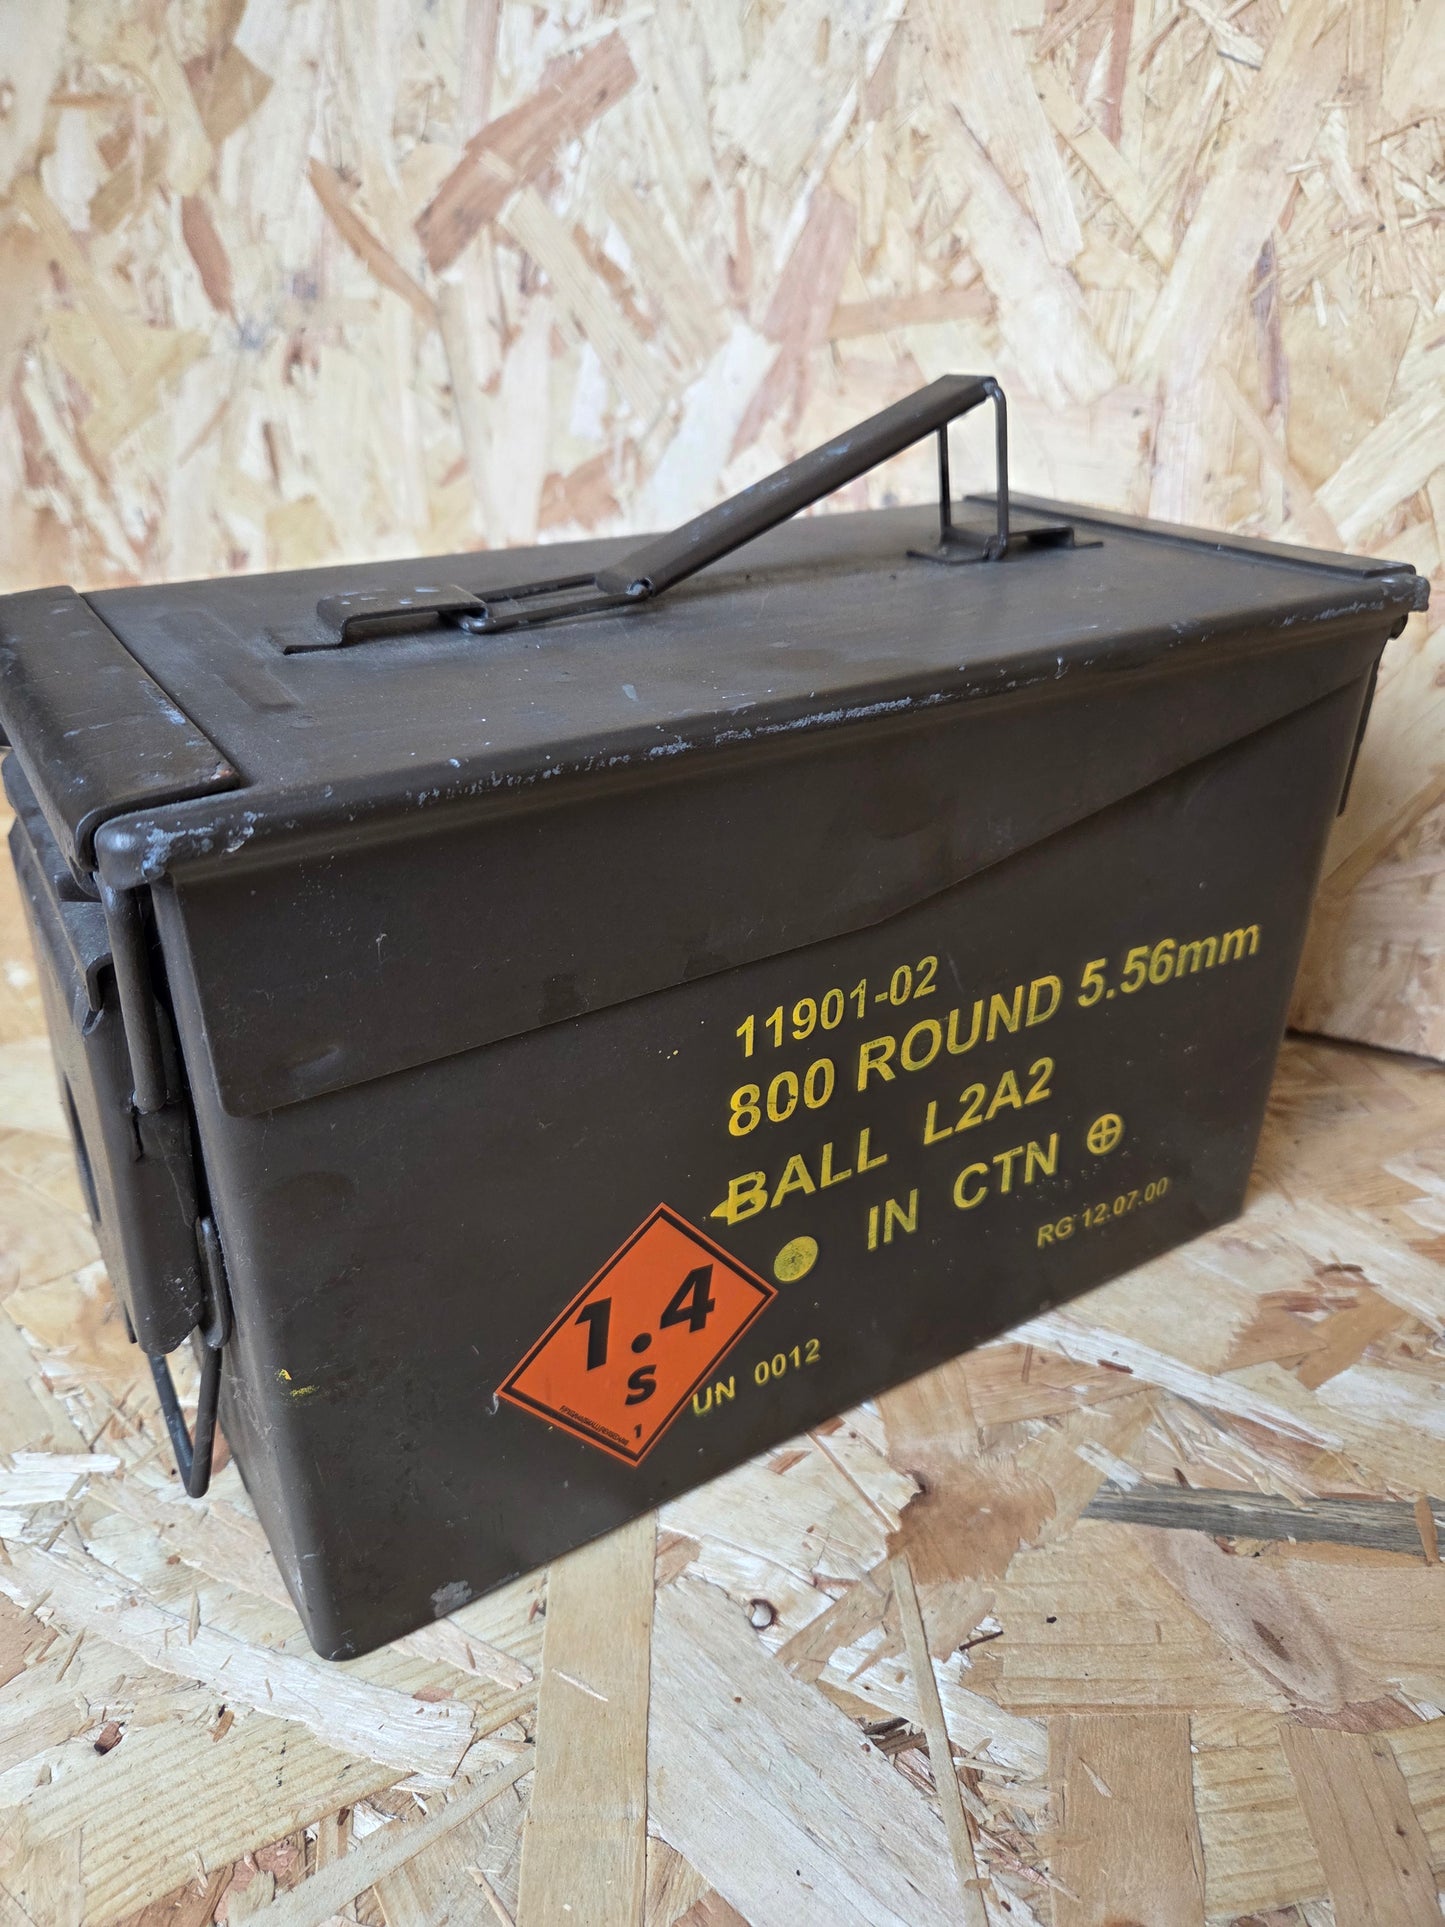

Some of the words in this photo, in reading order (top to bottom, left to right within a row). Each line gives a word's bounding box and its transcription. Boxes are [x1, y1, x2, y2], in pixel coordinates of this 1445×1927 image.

[727, 1057, 836, 1138] 800
[856, 974, 1063, 1092] ROUND
[1076, 923, 1261, 1008] 5.56mm
[736, 955, 939, 1058] 11901-02
[727, 1126, 889, 1226] BALL
[922, 1056, 1055, 1146] L2A2
[867, 1188, 920, 1252] IN
[952, 1133, 1060, 1210] CTN
[1037, 1215, 1075, 1249] RG
[1082, 1176, 1169, 1228] 12.07.00
[692, 1375, 736, 1415] UN
[753, 1337, 821, 1387] 0012
